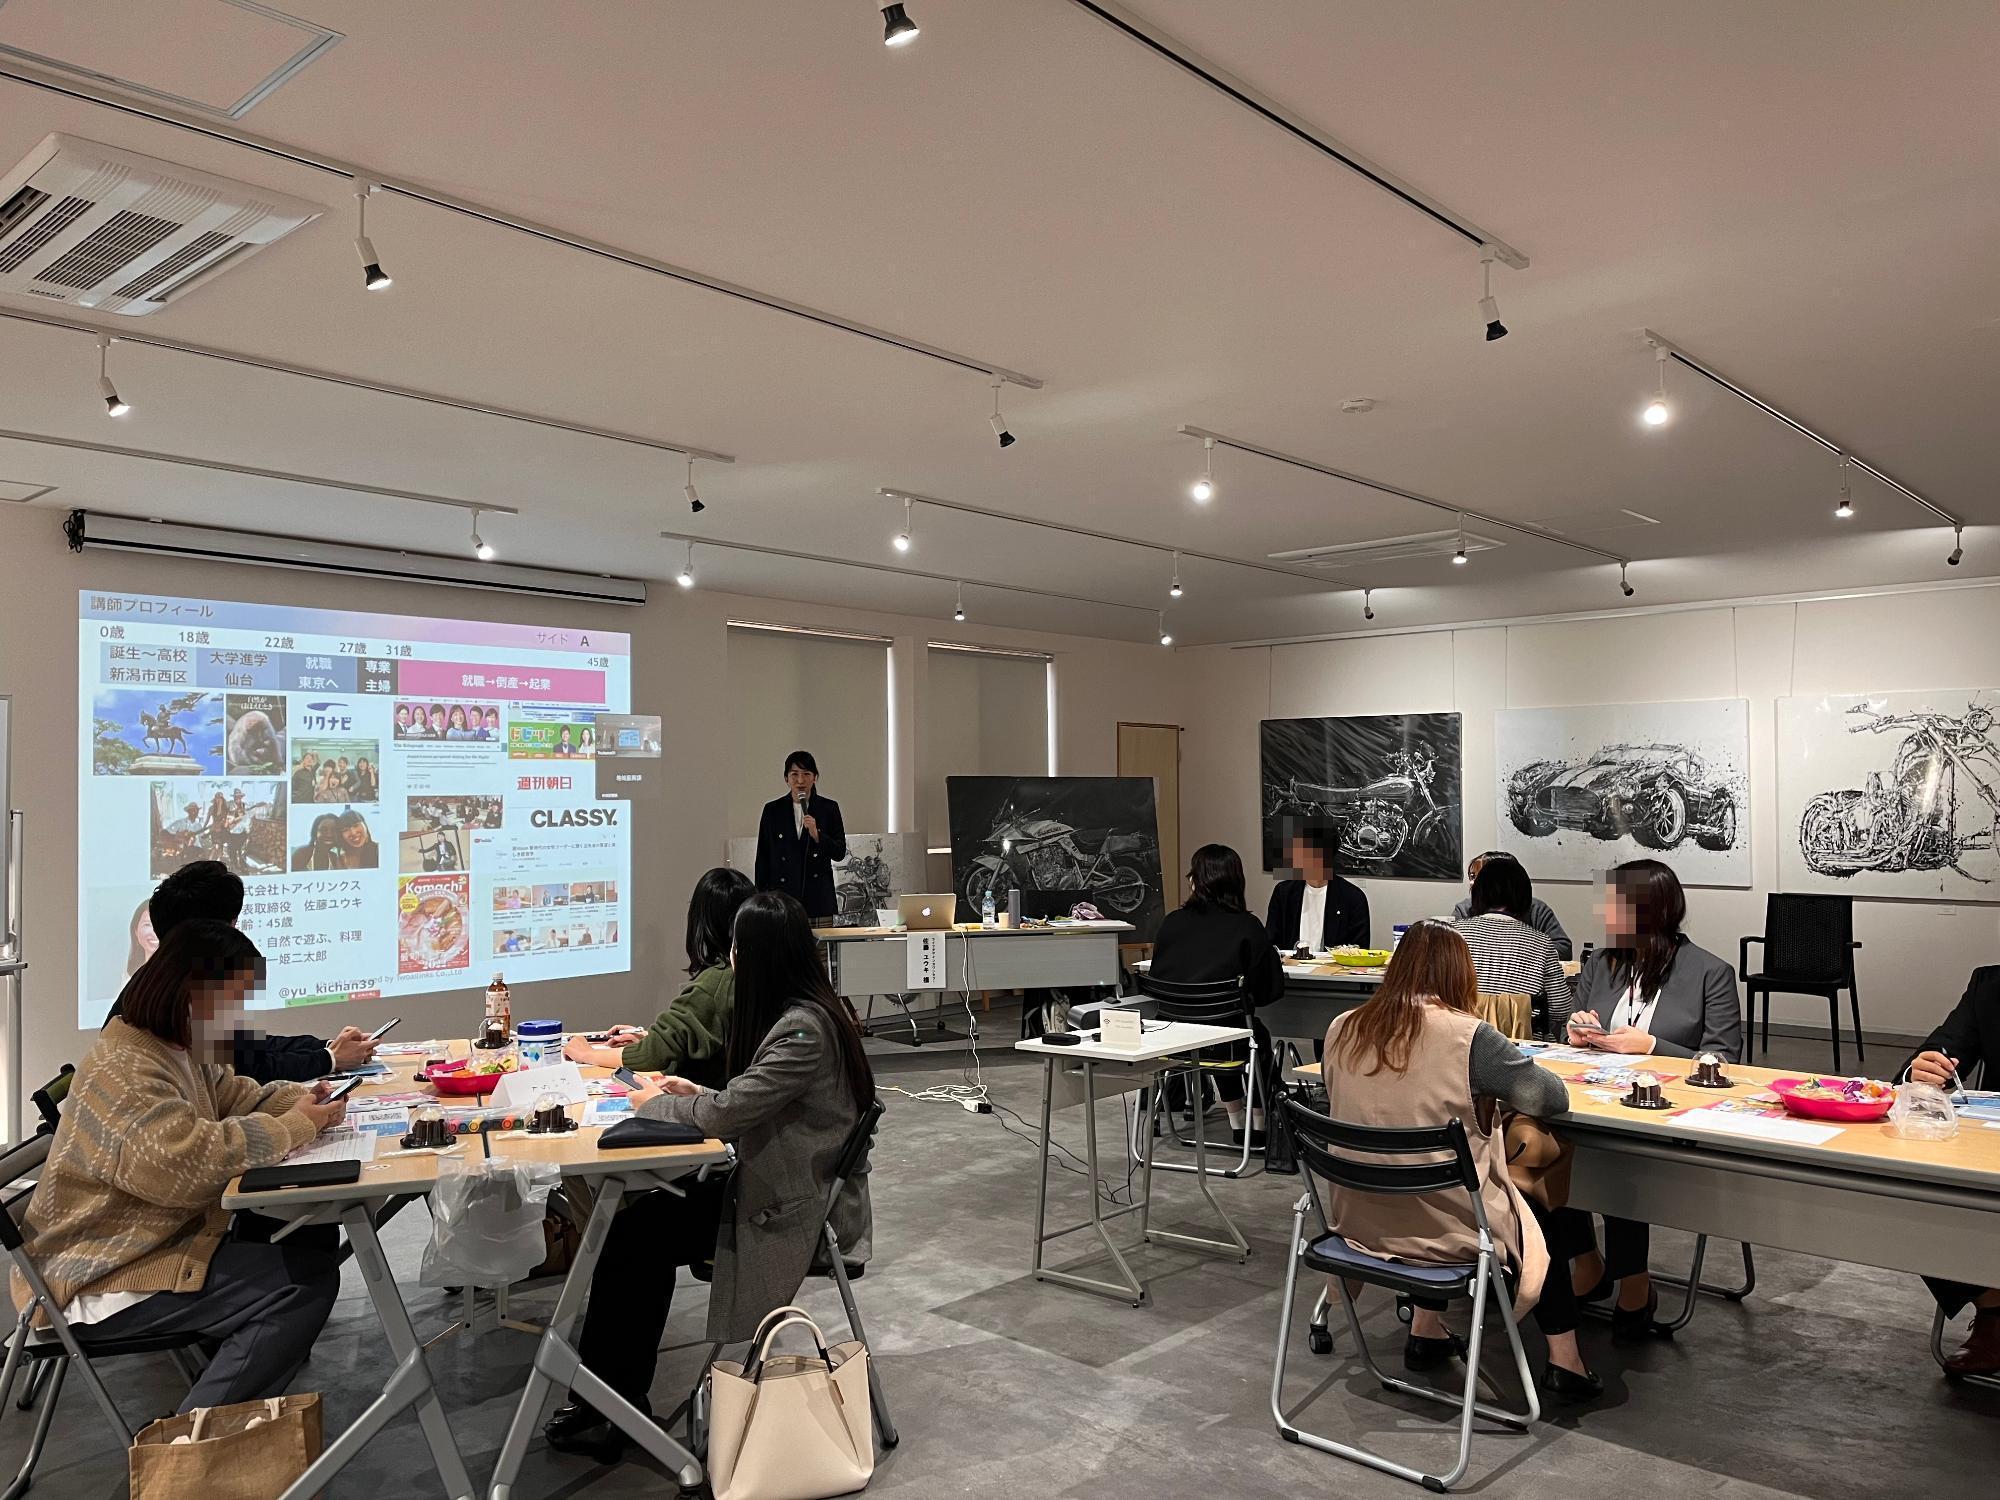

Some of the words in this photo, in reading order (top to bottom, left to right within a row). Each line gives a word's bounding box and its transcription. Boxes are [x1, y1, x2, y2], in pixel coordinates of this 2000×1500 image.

[91, 595, 214, 618] 講師プロフィール
[100, 625, 125, 640] 0歳
[179, 631, 210, 646] 18歳
[265, 637, 295, 650] 22歳
[339, 642, 366, 655] 27歳
[386, 644, 412, 657] 31歳
[587, 655, 609, 668] 45歳
[536, 631, 568, 645] サイド
[580, 636, 590, 647] A
[210, 651, 268, 667] 大学進学
[305, 656, 332, 670] 就職
[109, 666, 187, 683] 新潟市西区
[365, 660, 391, 674] 専業
[224, 674, 253, 687] 仙台
[298, 676, 338, 690] 東京へ
[365, 679, 391, 693] 主婦
[303, 715, 351, 731] リクナビ
[517, 776, 572, 791] 週刊朝日
[304, 897, 362, 912] 佐藤ユウキ
